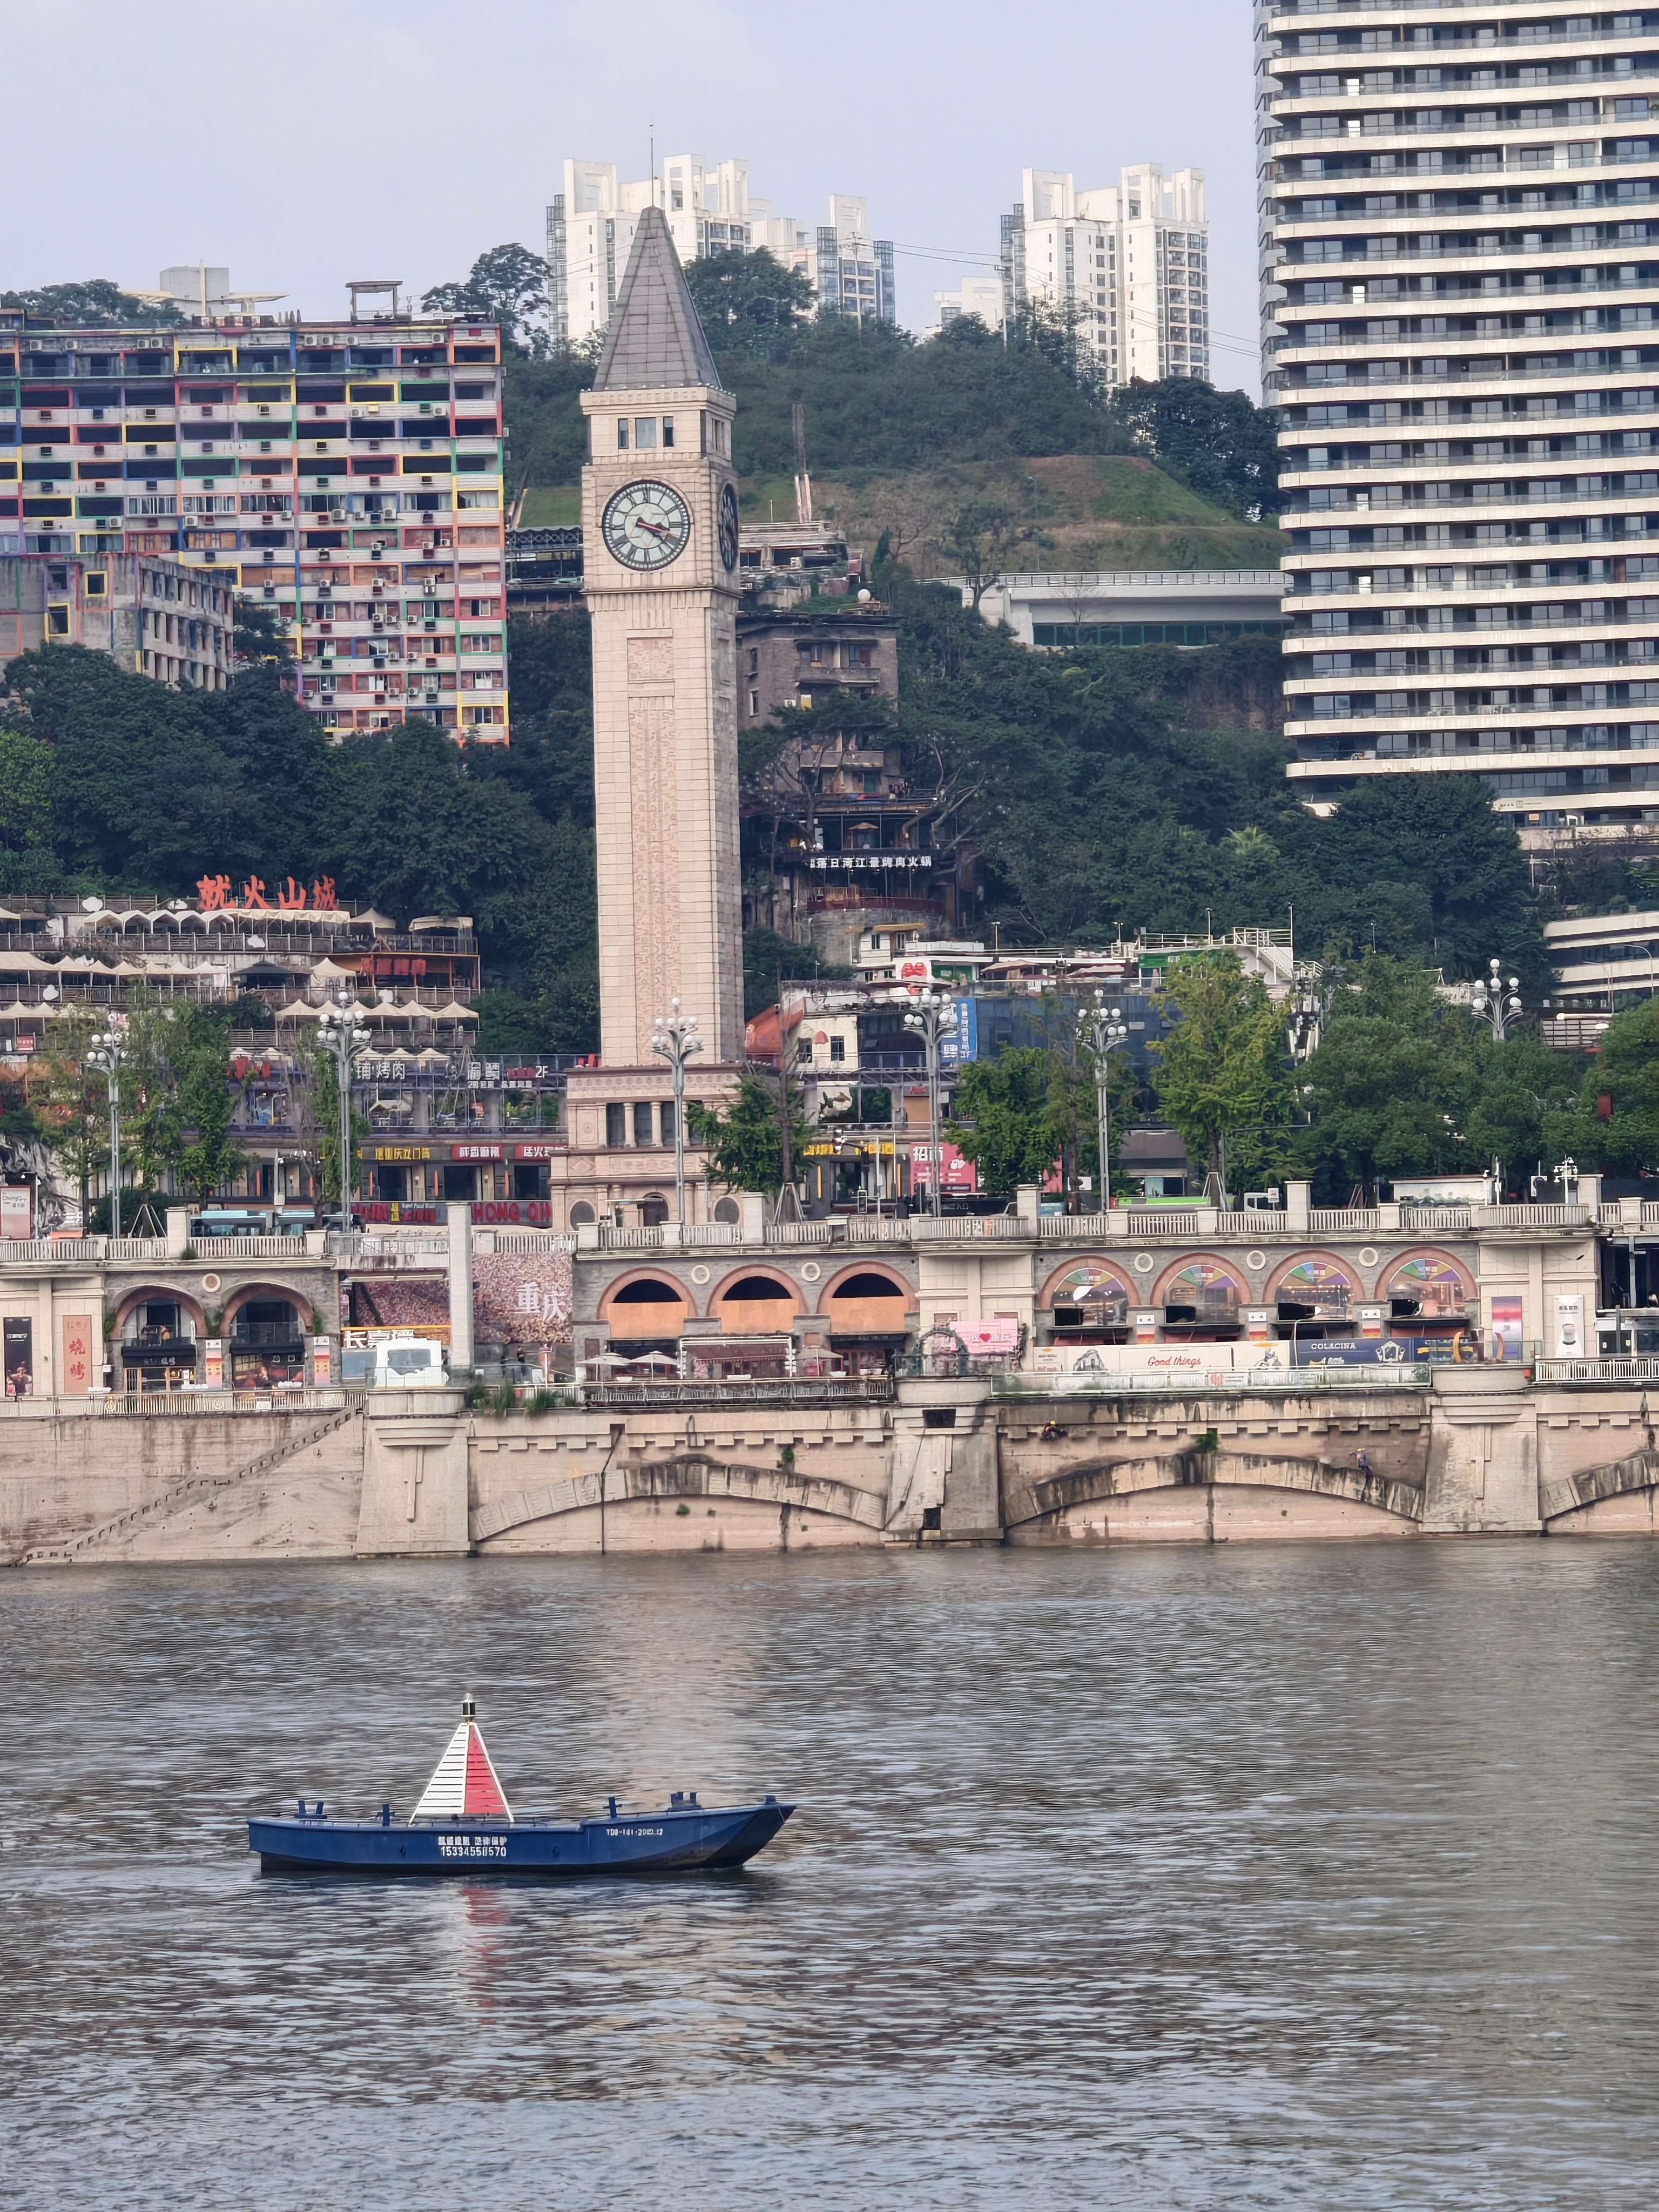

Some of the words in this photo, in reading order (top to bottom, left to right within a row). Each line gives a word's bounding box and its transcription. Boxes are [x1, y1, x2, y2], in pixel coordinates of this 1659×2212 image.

[535, 1065, 549, 1078] 2F
[514, 1282, 568, 1323] 重庆
[69, 1338, 86, 1380] 烧烤
[1148, 1356, 1172, 1366] Good
[1174, 1355, 1201, 1368] things
